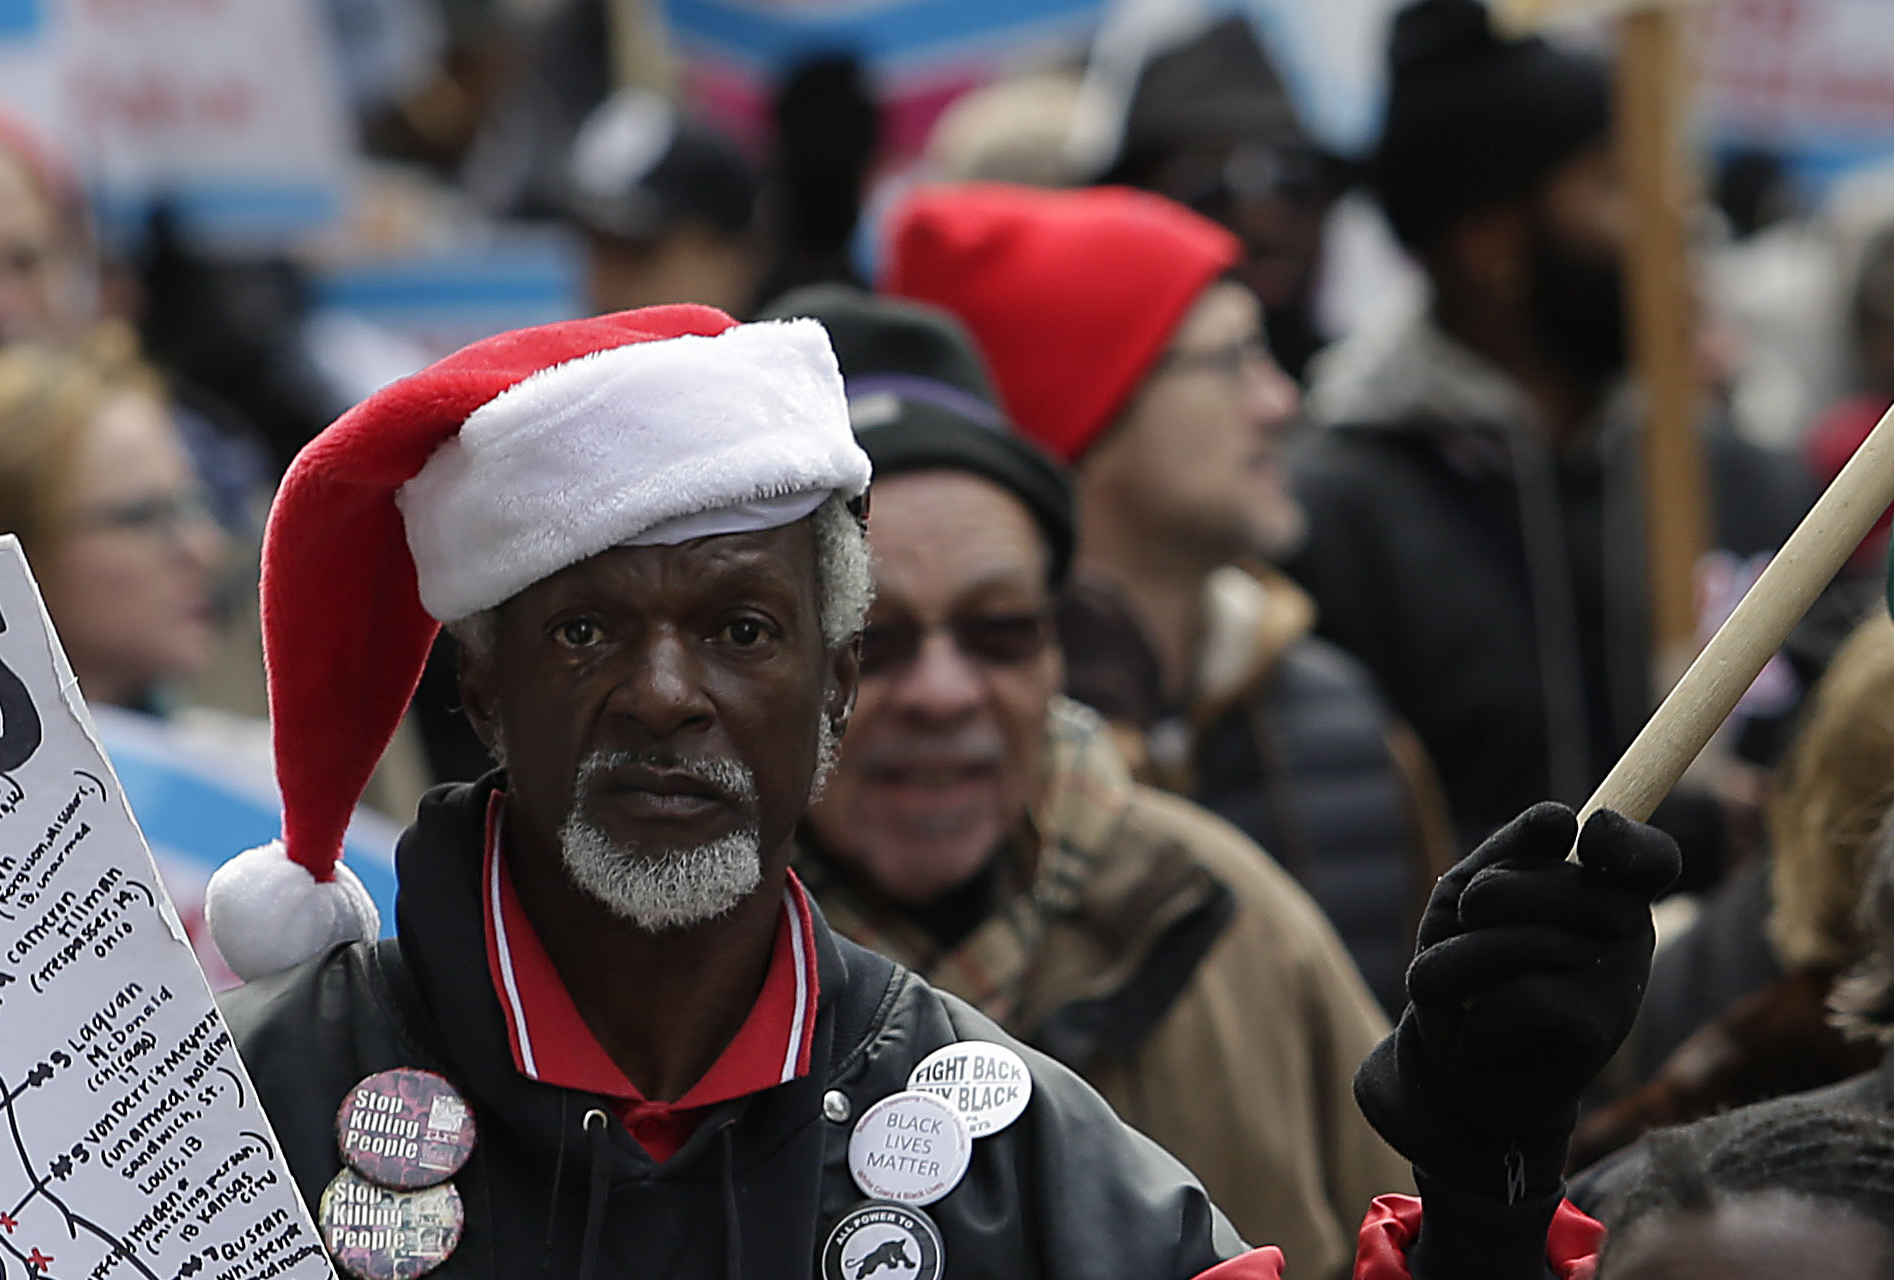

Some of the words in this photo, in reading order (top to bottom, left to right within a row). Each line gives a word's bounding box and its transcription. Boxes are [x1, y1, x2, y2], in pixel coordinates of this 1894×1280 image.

[67, 981, 145, 1054] Laquan
[86, 984, 174, 1070] McDonald
[914, 1054, 969, 1085] FIGHT
[972, 1054, 1023, 1082] BACK
[355, 1088, 405, 1116] Stop
[957, 1083, 1020, 1114] BLACK
[349, 1109, 421, 1140] Killing
[885, 1111, 944, 1136] BLACK
[345, 1129, 421, 1160] People
[884, 1132, 934, 1156] LIVES
[865, 1150, 941, 1179] MATTER
[333, 1181, 383, 1206] Stop
[331, 1202, 404, 1227] Killing
[836, 1221, 856, 1246] ALL
[852, 1211, 898, 1230] POWER
[896, 1214, 915, 1230] TO
[331, 1225, 407, 1252] People
